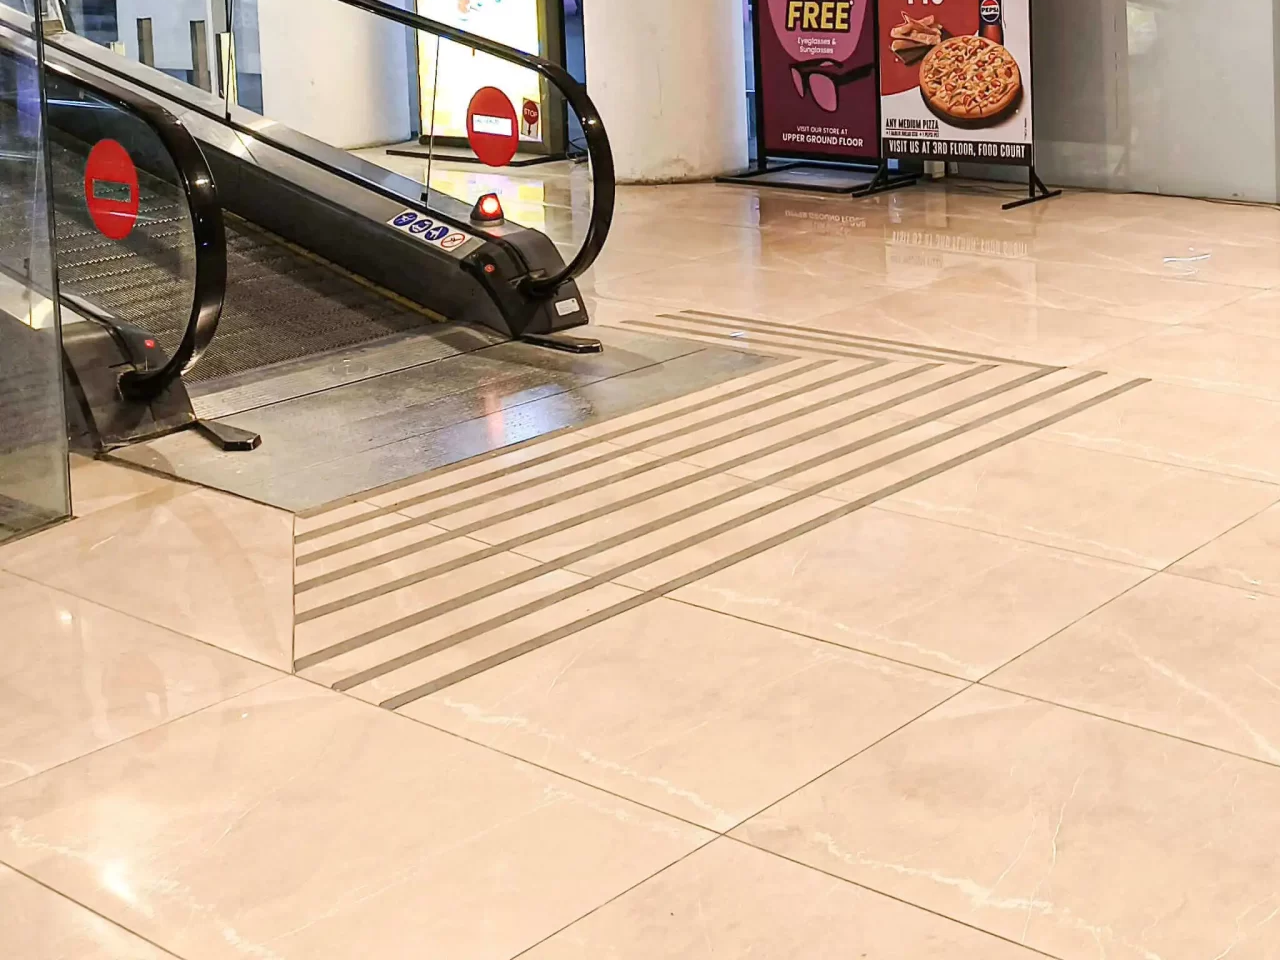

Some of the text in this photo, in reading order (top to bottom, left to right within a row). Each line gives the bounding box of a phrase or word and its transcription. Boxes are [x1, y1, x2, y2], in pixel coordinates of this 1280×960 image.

[797, 37, 830, 46] Eyeglasses
[800, 46, 833, 55] Sunglasses
[524, 108, 538, 117] STOP
[886, 118, 939, 129] ANY MEDIUM PIZZA
[823, 127, 840, 135] STORE
[782, 133, 863, 147] UPPER GROUND FLOOR
[889, 140, 1025, 158] VISIT US AT 3RD FLOOR, FOOD COURT
